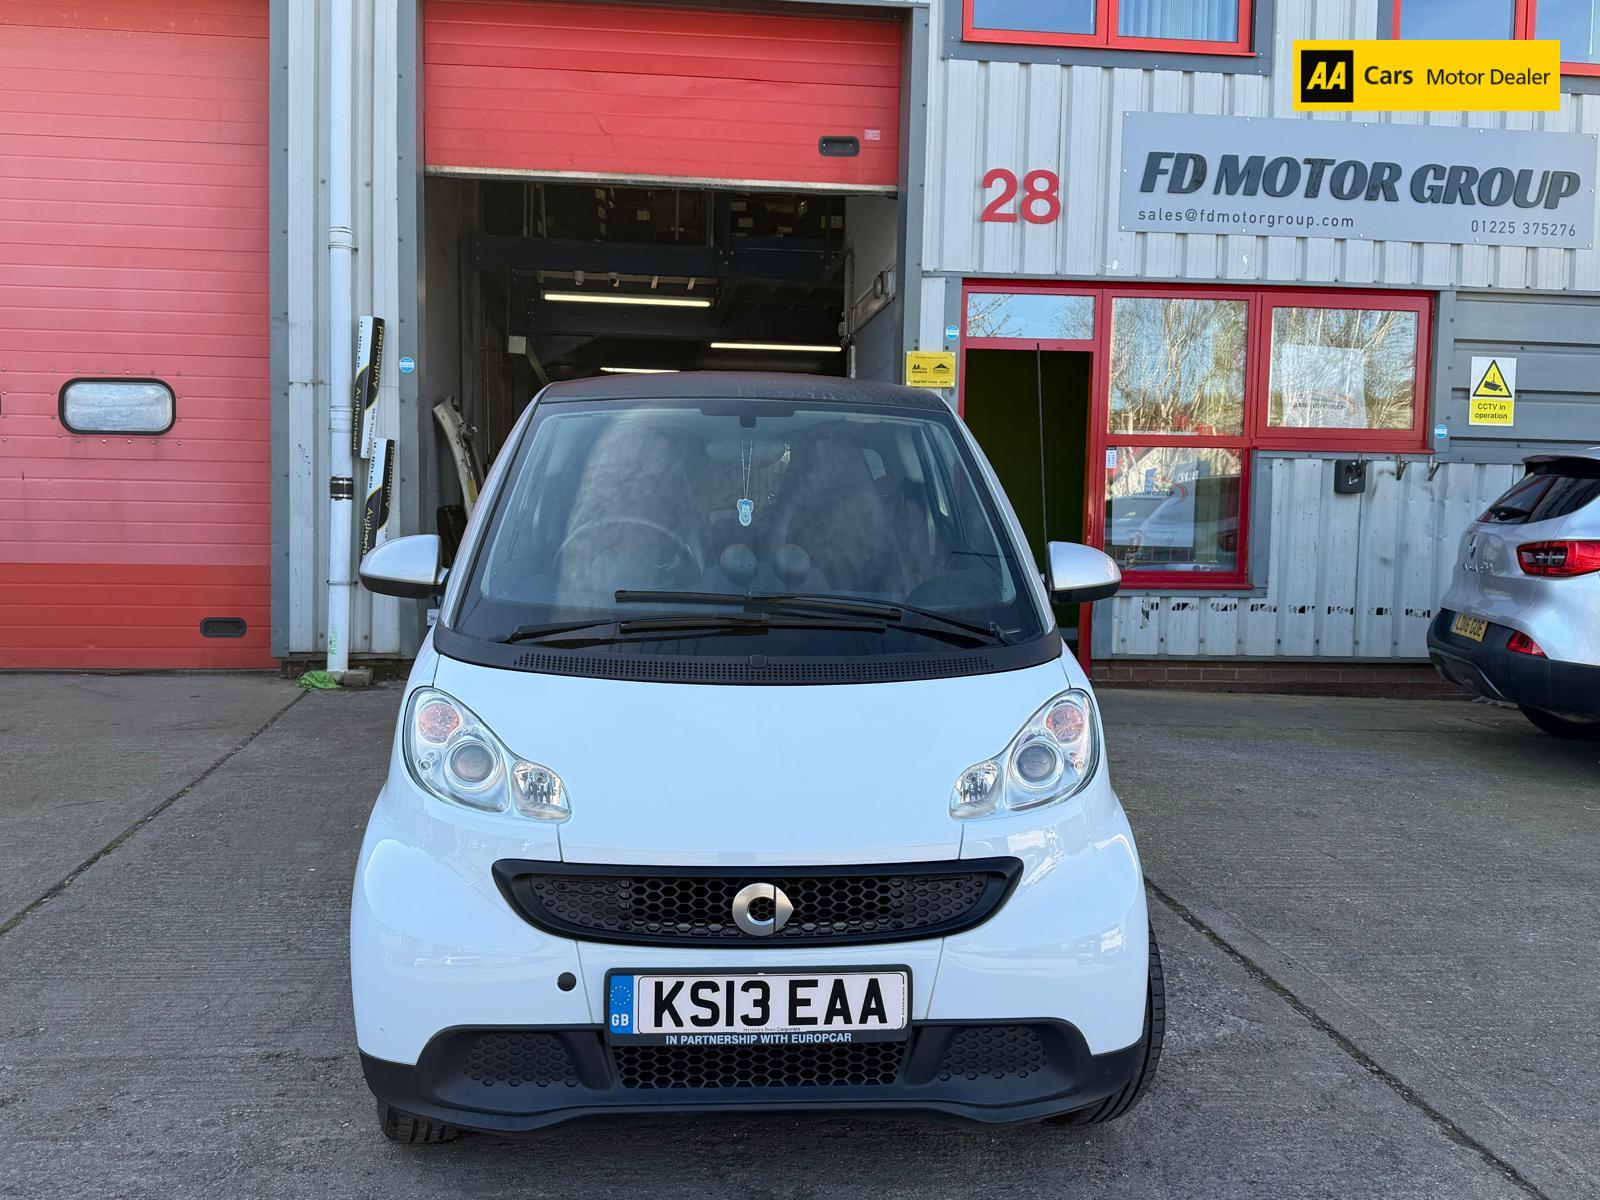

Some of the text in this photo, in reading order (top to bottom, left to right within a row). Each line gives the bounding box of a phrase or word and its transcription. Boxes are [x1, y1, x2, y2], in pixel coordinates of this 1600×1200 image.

[1139, 151, 1581, 210] FD MOTOR GROUP
[981, 167, 1061, 225] 28
[1138, 207, 1354, 229] sales@fdmotorgroup.com
[1471, 219, 1576, 237] 01225 375276
[1474, 412, 1508, 420] operation
[653, 980, 771, 1028] KS13
[788, 978, 888, 1025] EAA
[611, 1014, 630, 1027] GB
[665, 1033, 852, 1045] IN PARTNERSHIP WITH EUROPCAR
